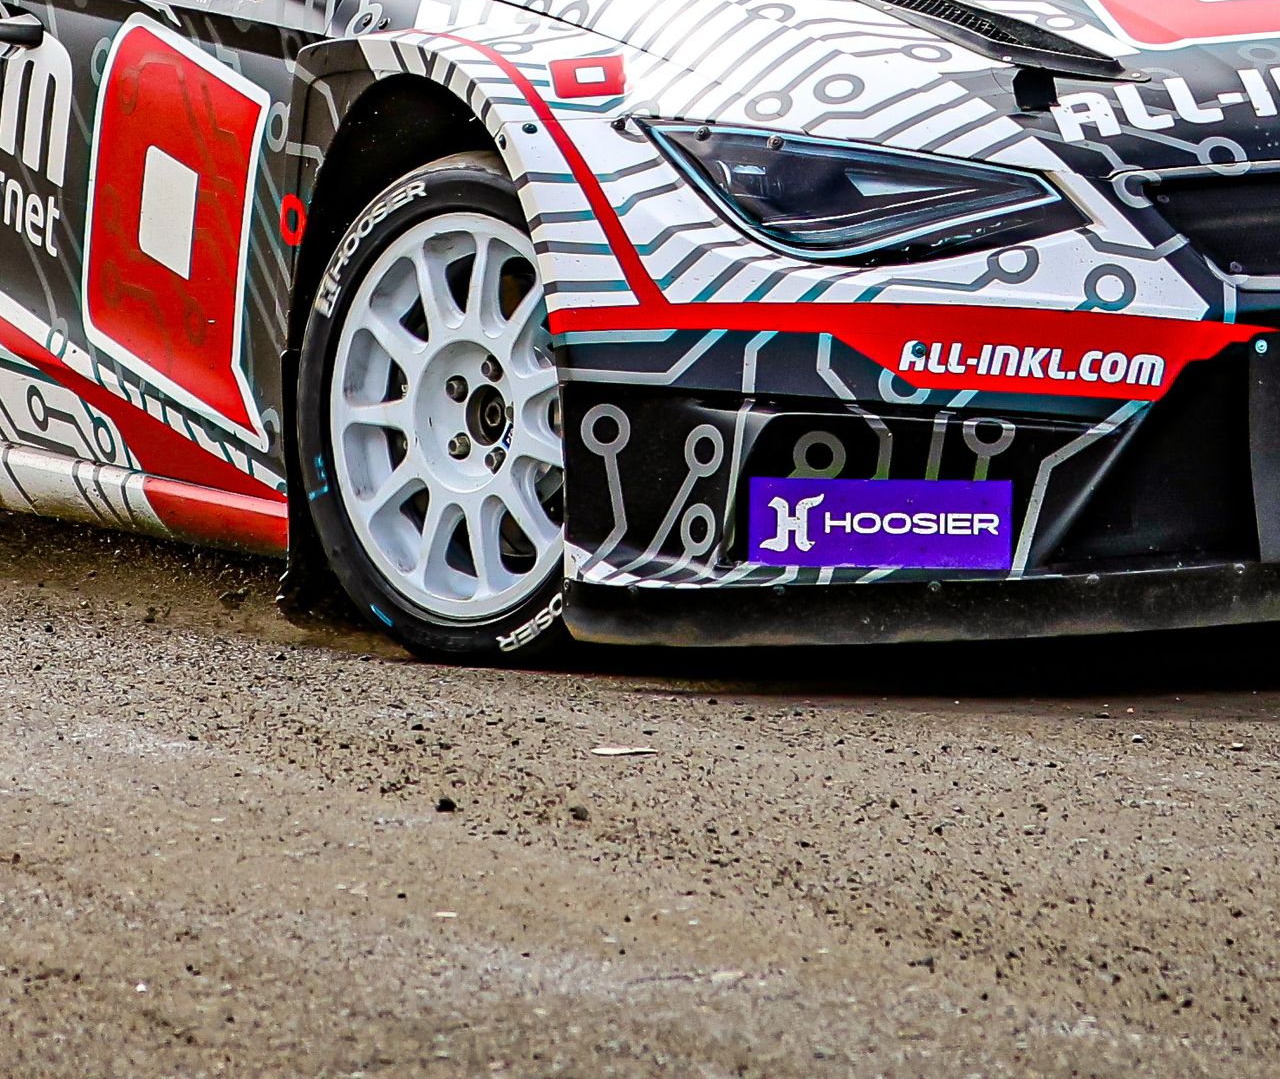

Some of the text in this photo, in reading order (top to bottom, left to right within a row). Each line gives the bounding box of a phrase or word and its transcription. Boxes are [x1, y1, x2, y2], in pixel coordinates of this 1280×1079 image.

[330, 180, 427, 281] HOOSIER
[824, 511, 999, 536] HOOSIER
[496, 592, 563, 652] OSIER
